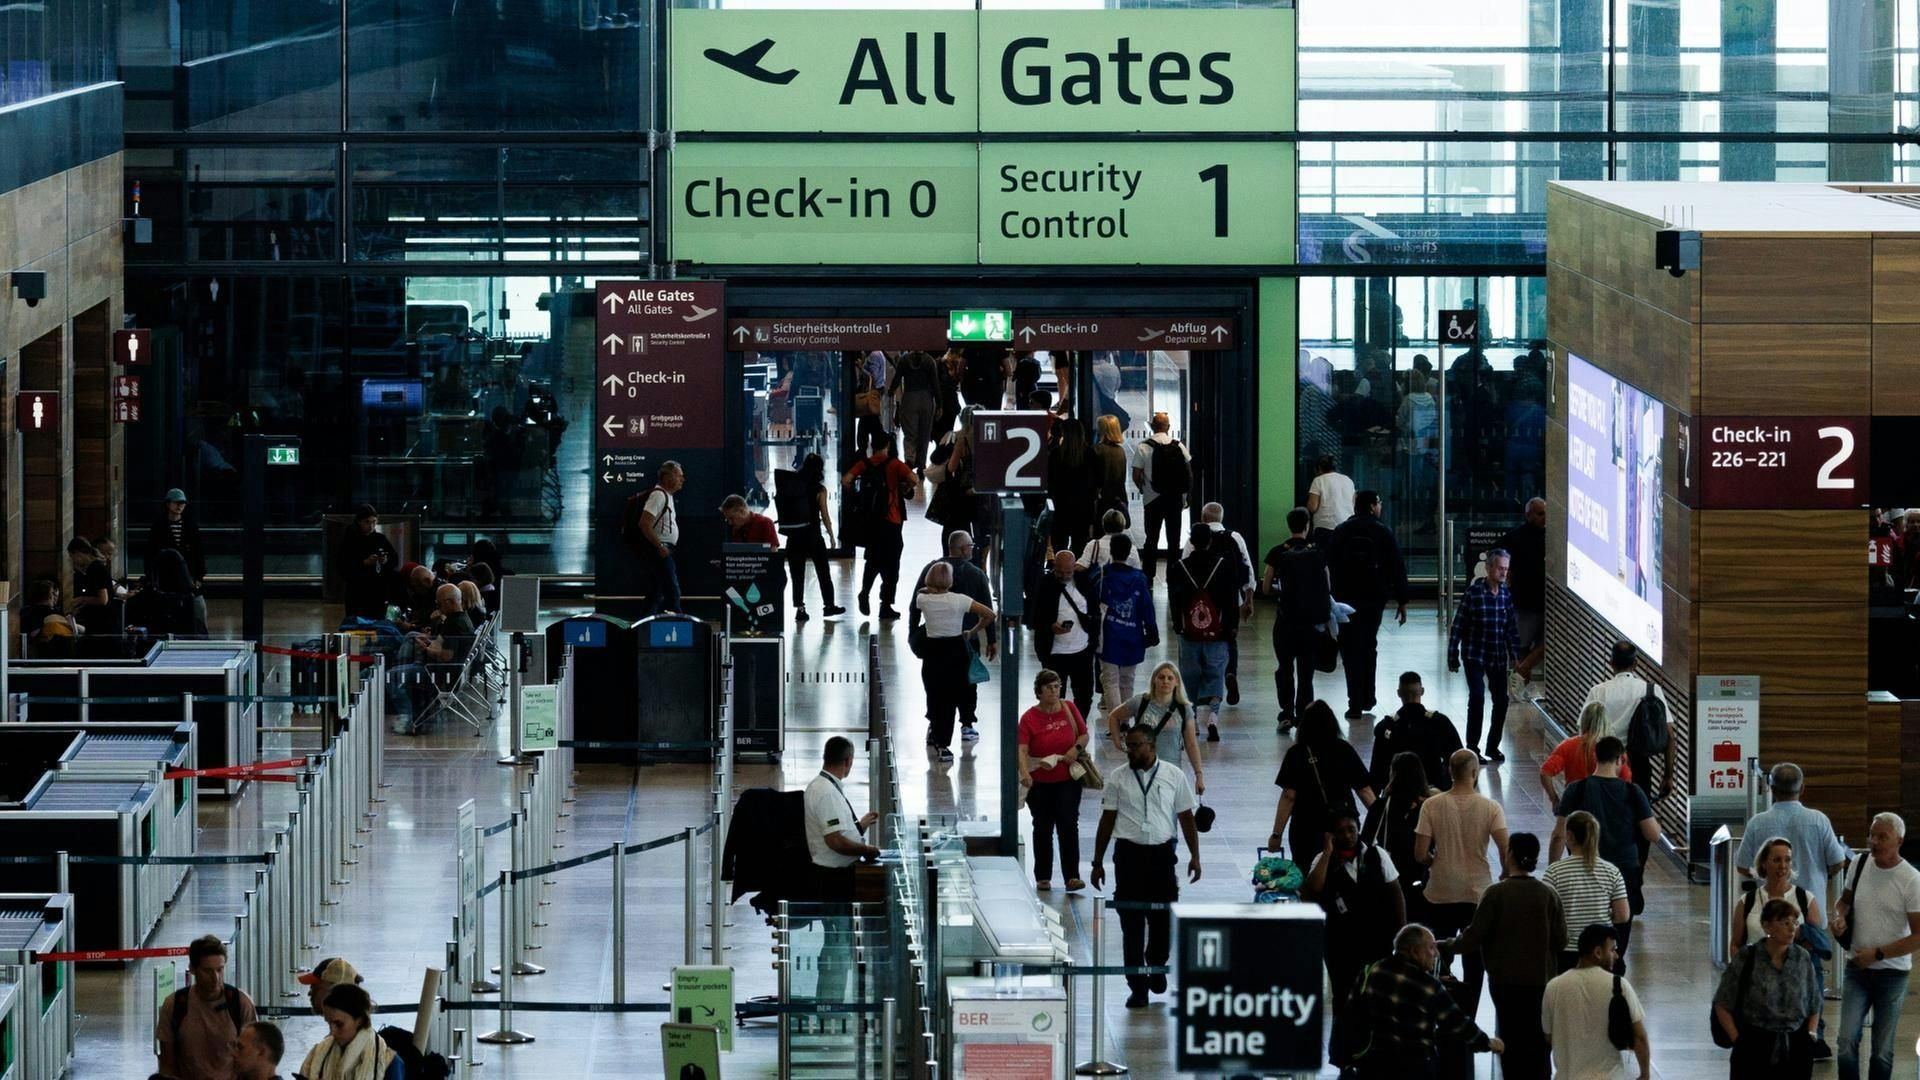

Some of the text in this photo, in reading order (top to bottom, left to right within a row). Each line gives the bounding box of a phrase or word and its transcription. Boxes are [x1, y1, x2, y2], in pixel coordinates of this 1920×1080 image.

[839, 32, 1234, 105] All Gates
[1000, 163, 1142, 200] Security
[684, 177, 936, 218] Check-in 0
[1198, 164, 1229, 237] 1
[1000, 209, 1128, 238] Control
[627, 289, 695, 301] Alle Gates
[627, 304, 673, 315] All Gates
[773, 323, 891, 334] Sicherheitskontrolle 1
[1040, 323, 1098, 334] Check-in 0
[1170, 323, 1207, 336] Abflug
[773, 335, 840, 345] Security Control
[1165, 335, 1208, 346] Departure
[628, 371, 685, 383] Check-in
[628, 386, 637, 398] 0
[1712, 426, 1791, 443] Check-in
[1005, 427, 1041, 487] 2
[1816, 426, 1855, 489] 2
[1186, 984, 1316, 1026] Priority
[959, 1013, 989, 1025] BER
[1186, 1026, 1266, 1056] Lane
